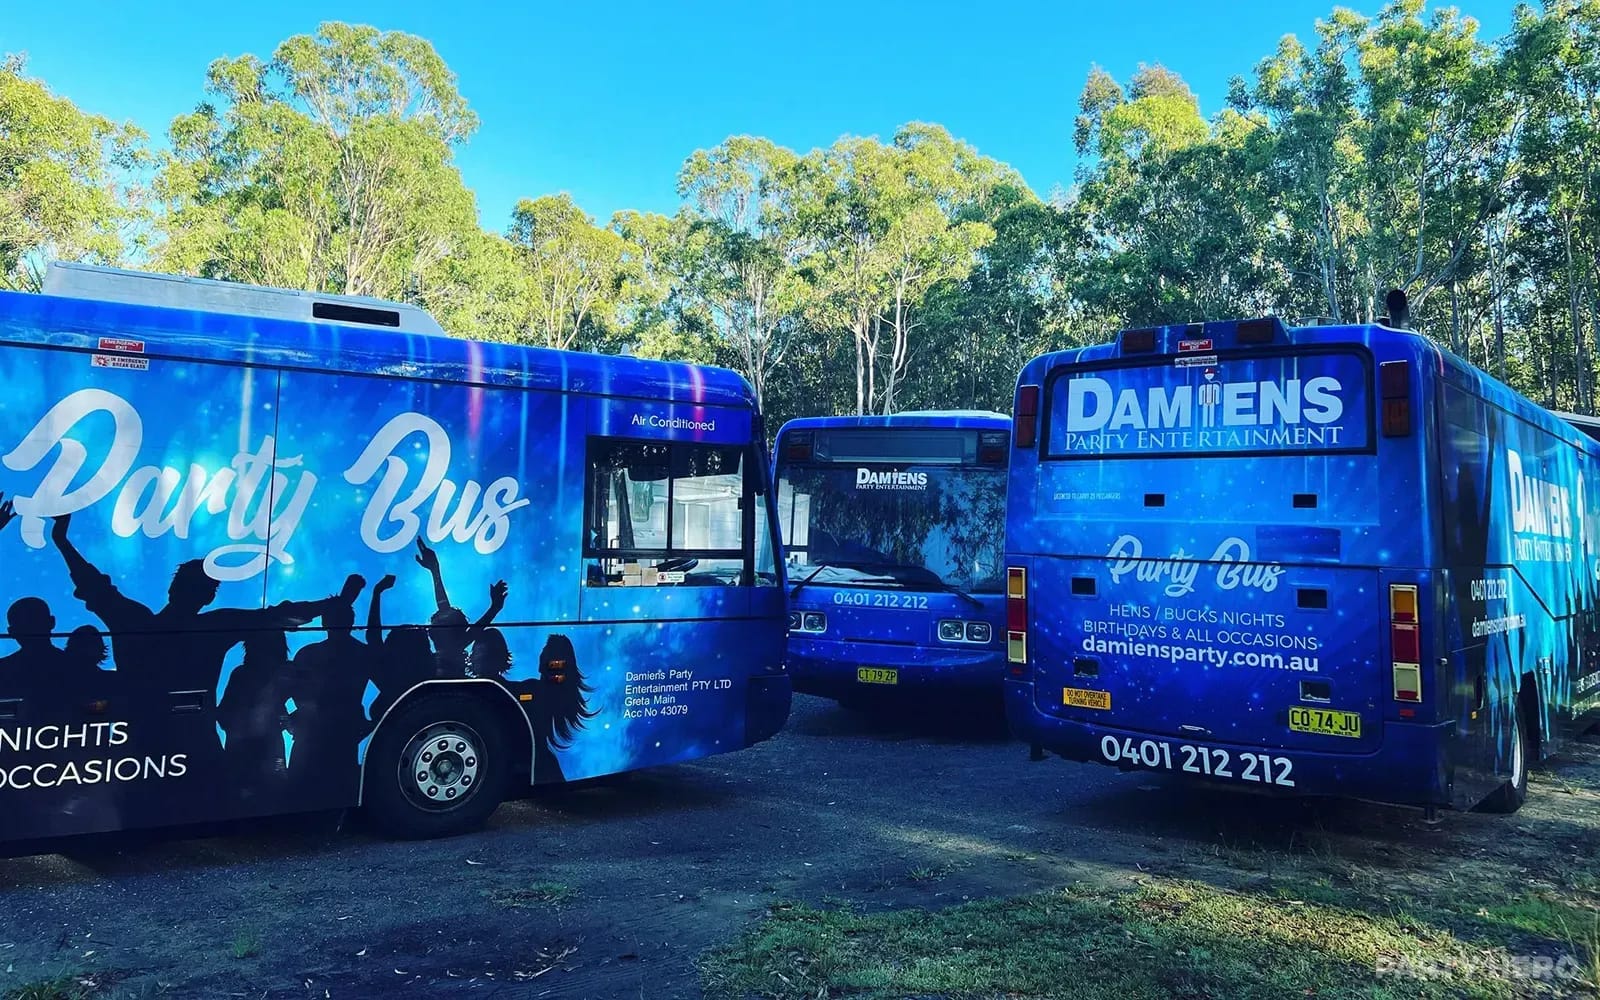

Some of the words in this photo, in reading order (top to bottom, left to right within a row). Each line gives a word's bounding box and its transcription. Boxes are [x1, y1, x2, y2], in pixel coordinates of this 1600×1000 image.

[1067, 377, 1343, 432] DAMIENS
[631, 414, 646, 426] Air
[649, 415, 715, 431] Conditioned
[1065, 432, 1129, 451] PARTY
[1137, 426, 1344, 449] ENTERTAINMENT
[2, 388, 318, 582] Party
[343, 412, 530, 554] Bus
[856, 467, 928, 485] DAMIENS
[1106, 534, 1200, 597] Party
[1209, 537, 1286, 592] Bus
[833, 591, 870, 606] 0401
[874, 594, 899, 608] 212
[902, 596, 928, 609] 212
[1110, 604, 1151, 618] HENS
[1154, 606, 1161, 621] /
[1165, 608, 1218, 623] BUCKS
[1223, 612, 1285, 628] NIGHTS
[1083, 620, 1167, 639] BIRTHDAYS
[1171, 628, 1182, 640] &
[1185, 628, 1213, 643] ALL
[1217, 631, 1318, 650] OCCASIONS
[1082, 636, 1319, 673] damiensparty.com.au
[669, 669, 693, 680] Party
[858, 669, 869, 680] CT
[872, 670, 883, 680] 79
[625, 683, 688, 695] Entertainment
[692, 680, 711, 691] PTY
[714, 679, 732, 690] LTD
[623, 709, 643, 719] Acc
[644, 707, 658, 717] No
[660, 704, 688, 716] 43079
[624, 696, 650, 707] Greta
[653, 694, 676, 705] Main
[1314, 711, 1334, 730] 74
[1339, 715, 1359, 732] JU
[0, 721, 128, 751] NIGHTS
[0, 754, 188, 789] CCASIONS
[1101, 734, 1173, 770] 0401
[1181, 745, 1233, 778] 212
[1239, 753, 1296, 788] 212
